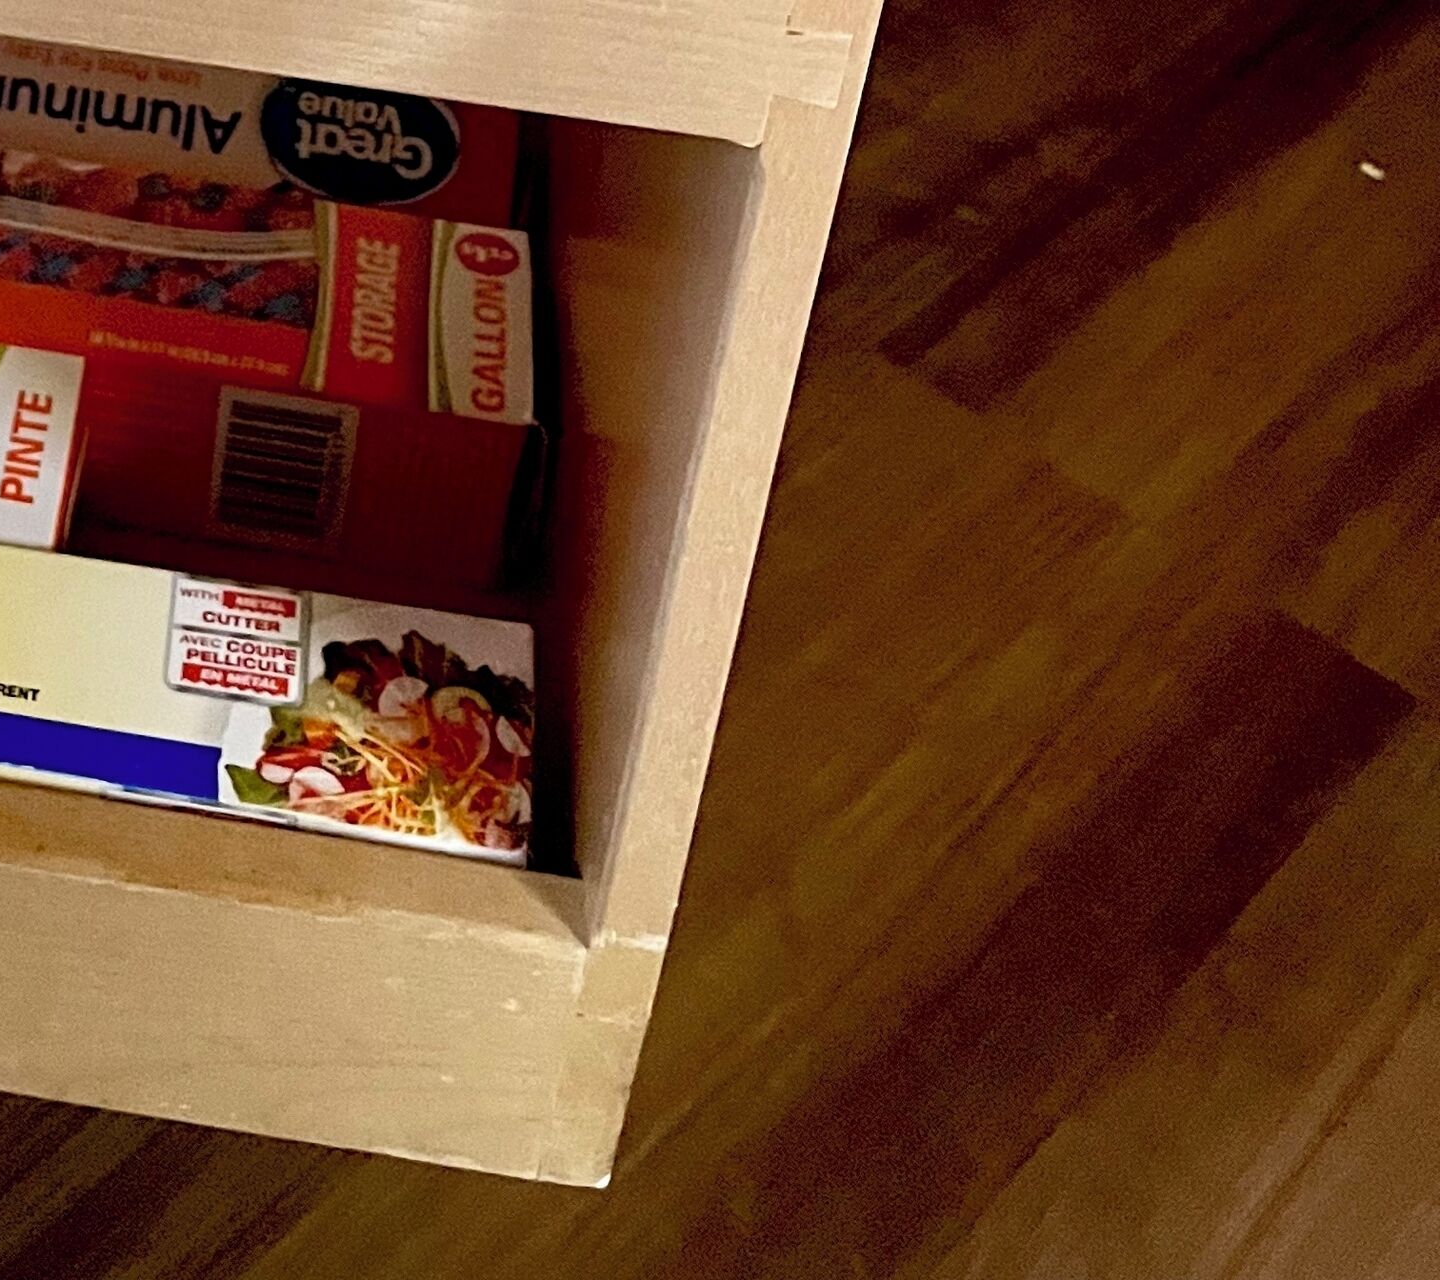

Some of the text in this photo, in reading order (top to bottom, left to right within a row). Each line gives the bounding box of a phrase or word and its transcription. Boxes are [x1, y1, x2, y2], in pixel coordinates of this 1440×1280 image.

[296, 90, 402, 135] Value
[294, 118, 434, 180] Great
[349, 235, 402, 365] STORAGE
[470, 276, 509, 414] GALLON
[179, 587, 220, 601] WITH
[202, 610, 281, 633] CUTTER
[178, 633, 298, 662] AVEC COUPE
[185, 647, 297, 677] PELLICULE
